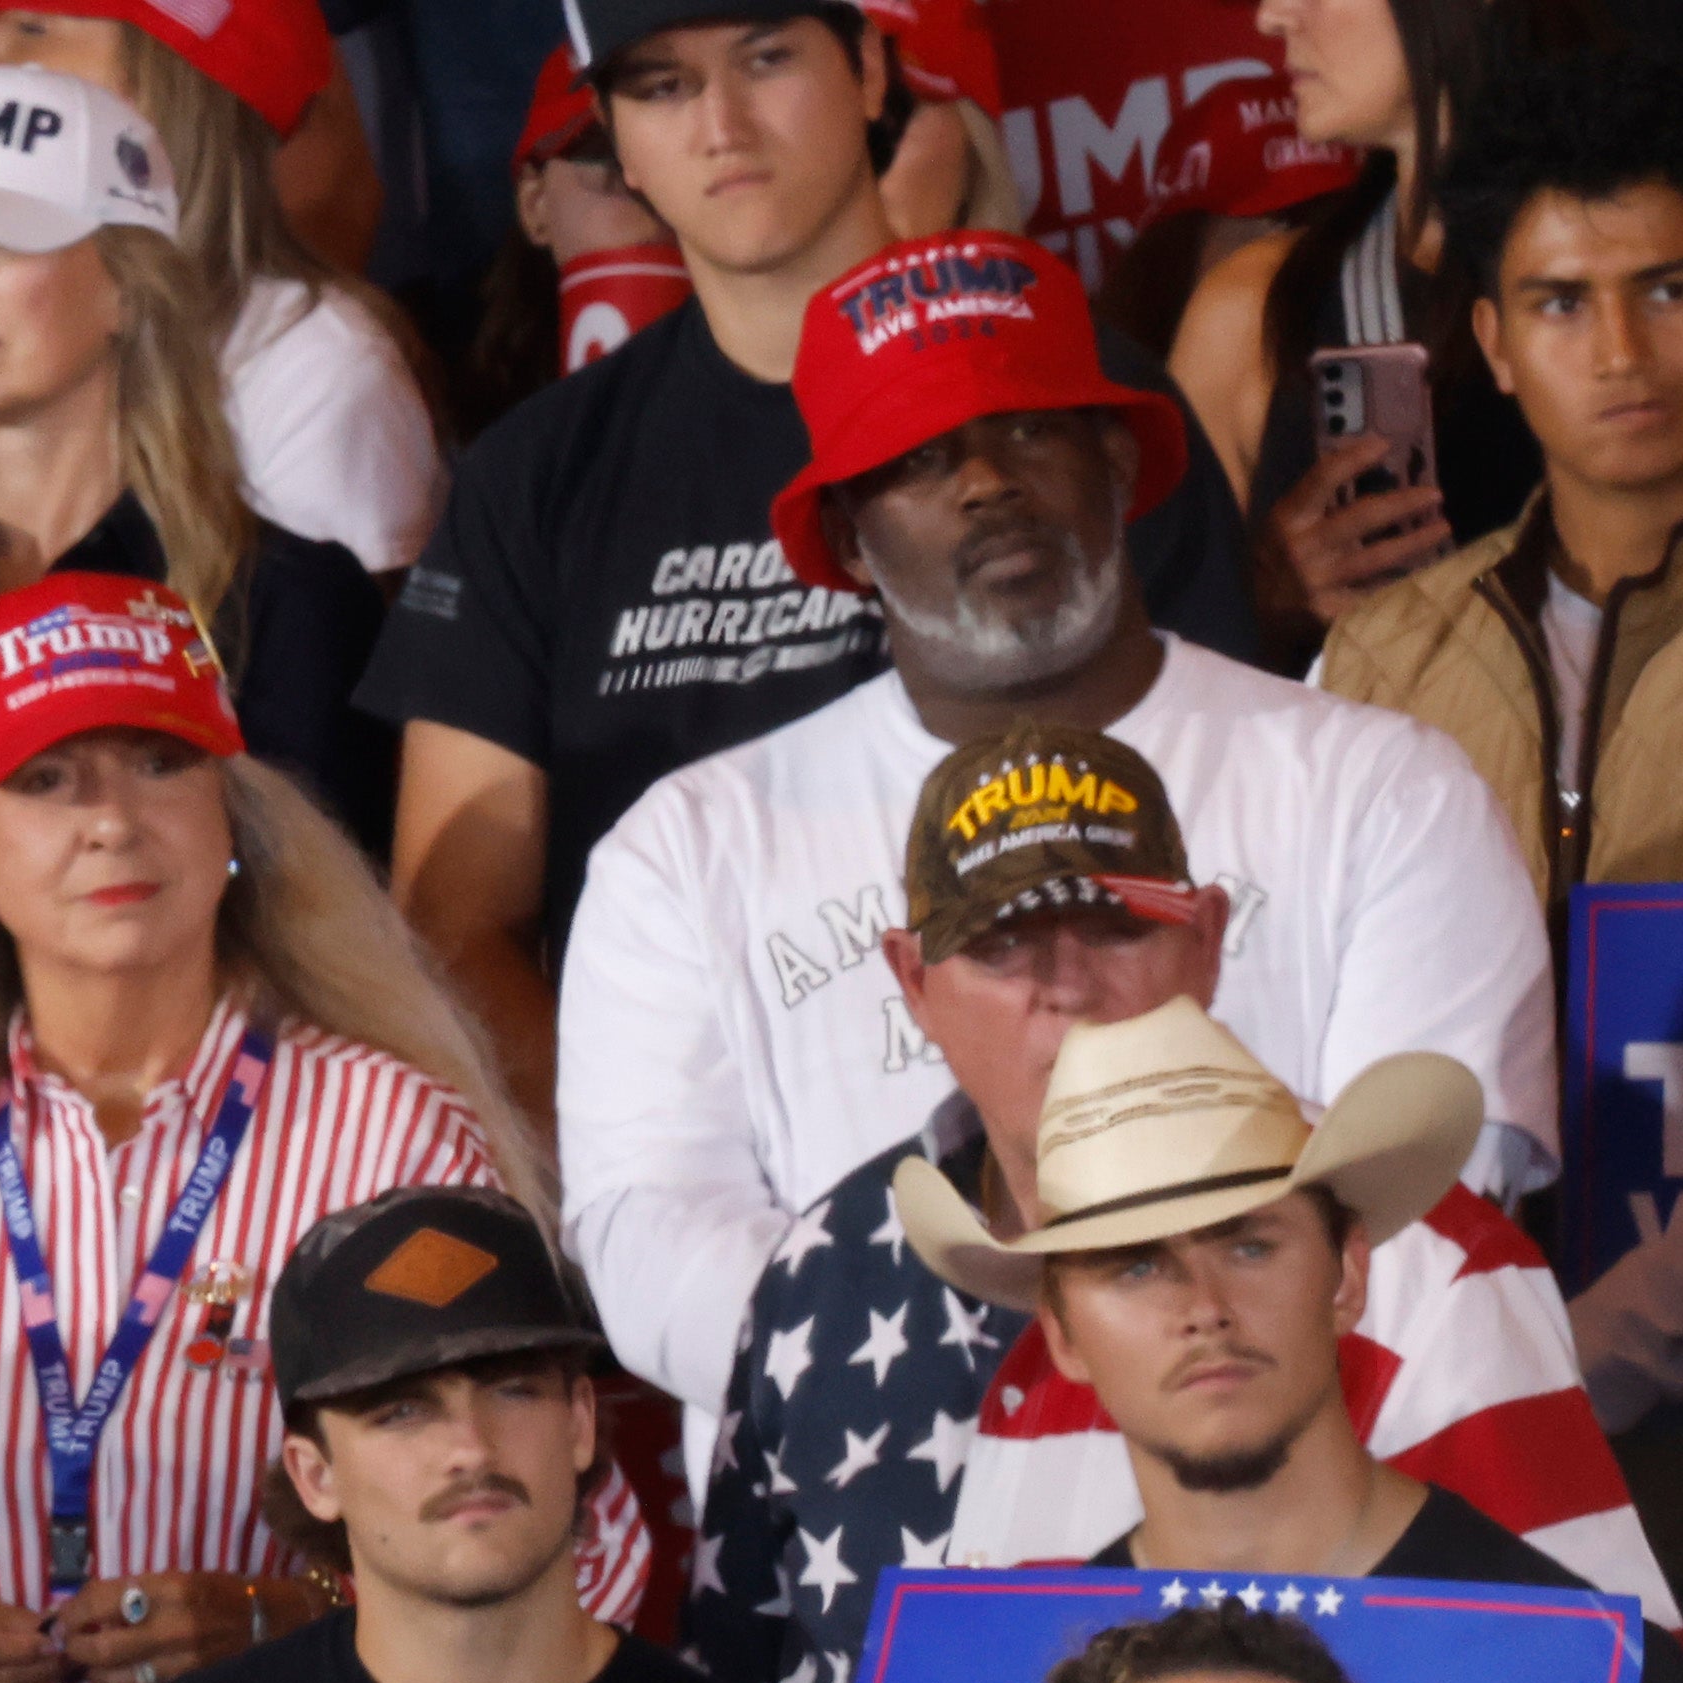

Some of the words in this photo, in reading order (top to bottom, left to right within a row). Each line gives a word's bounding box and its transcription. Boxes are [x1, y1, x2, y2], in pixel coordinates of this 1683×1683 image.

[840, 257, 1038, 338] TRUMP
[860, 311, 918, 356] SAVE
[925, 297, 1034, 322] AMERICA
[651, 538, 797, 596] CARO
[947, 763, 1139, 842] TRUMP
[999, 822, 1082, 852] AMERICA
[167, 1135, 229, 1234] TRUMP
[66, 1358, 125, 1454] TRUMP
